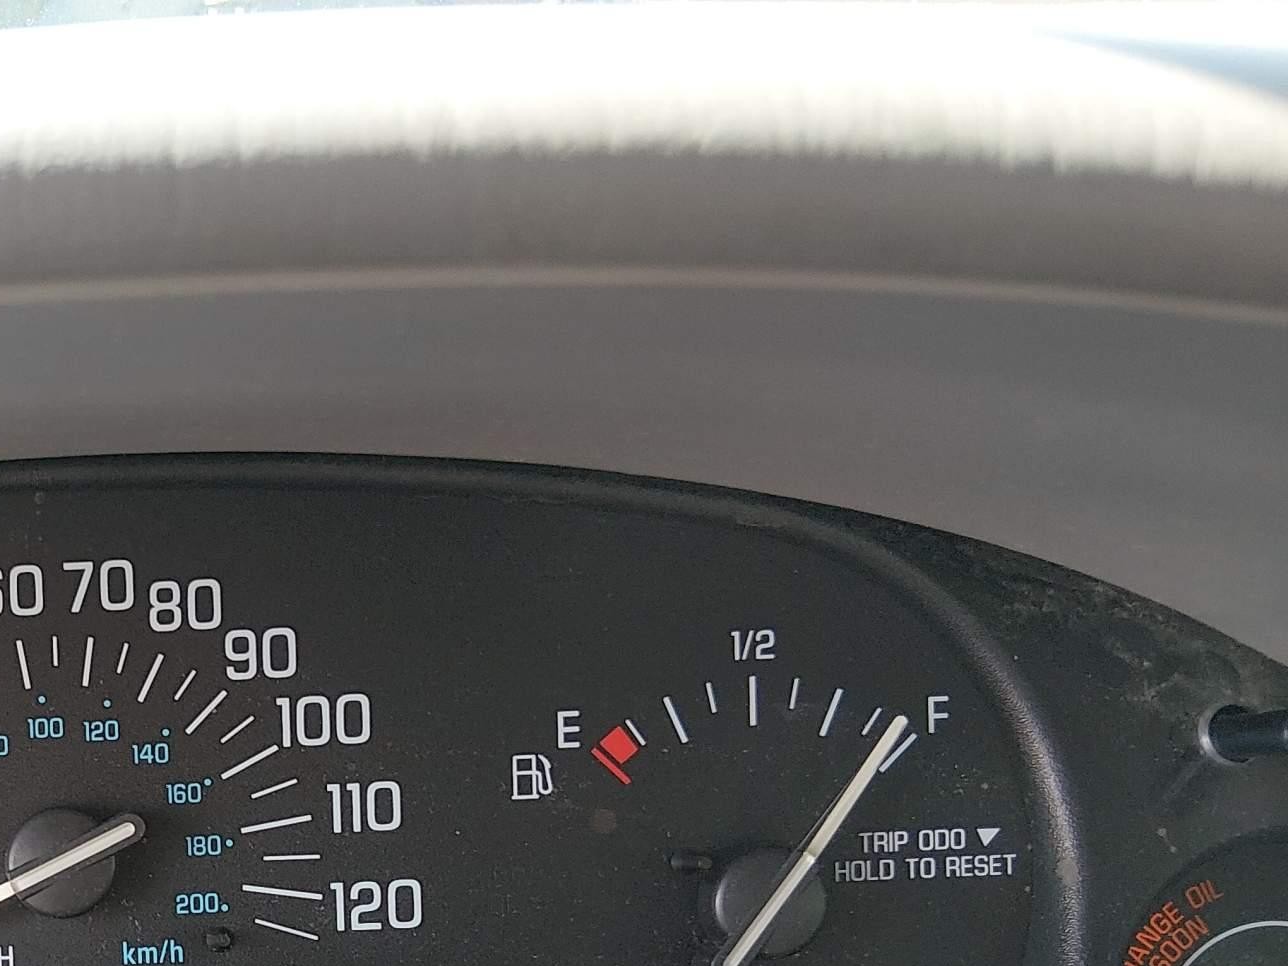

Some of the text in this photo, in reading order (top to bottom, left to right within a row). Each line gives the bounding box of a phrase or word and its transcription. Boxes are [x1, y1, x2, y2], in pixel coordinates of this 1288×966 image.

[62, 559, 134, 613] 70
[149, 578, 222, 632] 80
[224, 627, 297, 681] 90
[730, 629, 776, 661] 1/2
[27, 717, 64, 739] 100
[275, 693, 372, 748] 100
[557, 710, 581, 749] E
[927, 695, 949, 734] F
[83, 720, 119, 742] 120
[132, 742, 169, 764] 140
[165, 782, 202, 804] 160
[326, 780, 402, 834] 110
[185, 834, 222, 857] 180
[858, 828, 966, 853] TRIP ODO
[835, 853, 1017, 882] HOLD TO RESET
[176, 892, 219, 915] 200
[329, 878, 422, 932] 120
[1184, 879, 1225, 909] OIL
[122, 939, 184, 965] km/h
